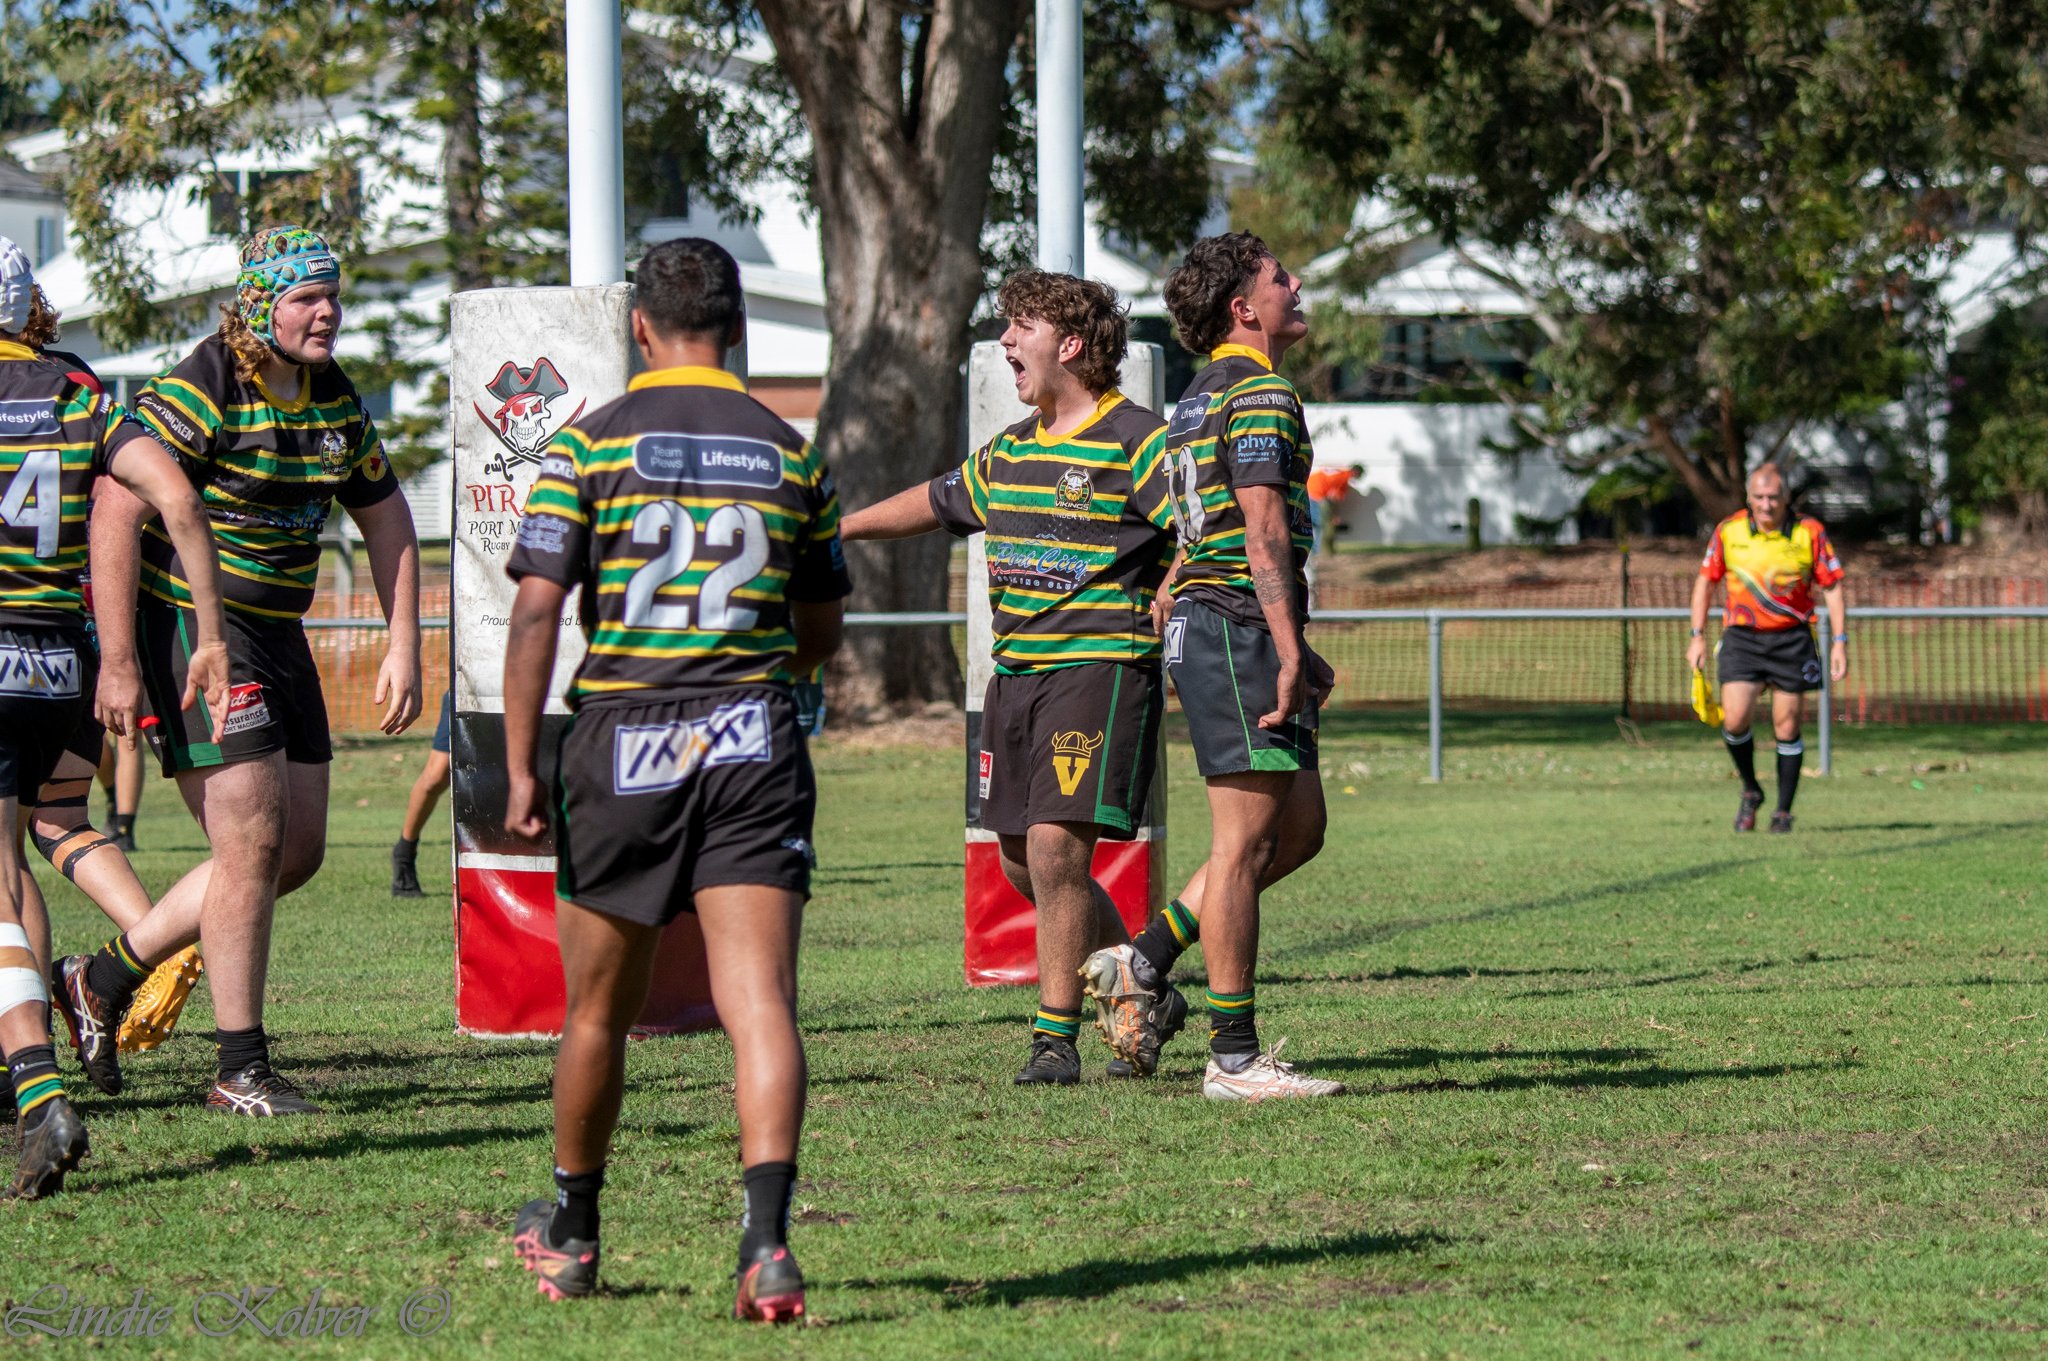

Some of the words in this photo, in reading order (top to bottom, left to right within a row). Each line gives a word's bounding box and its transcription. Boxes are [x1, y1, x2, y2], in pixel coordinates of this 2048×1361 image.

[0, 410, 54, 424] ifestyle.
[652, 446, 682, 458] Team
[701, 451, 774, 472] Lifestyle.
[1055, 501, 1090, 511] VIKINGS
[468, 519, 506, 538] PORT
[624, 498, 770, 632] 22
[995, 543, 1036, 568] Port
[1036, 547, 1088, 581] City
